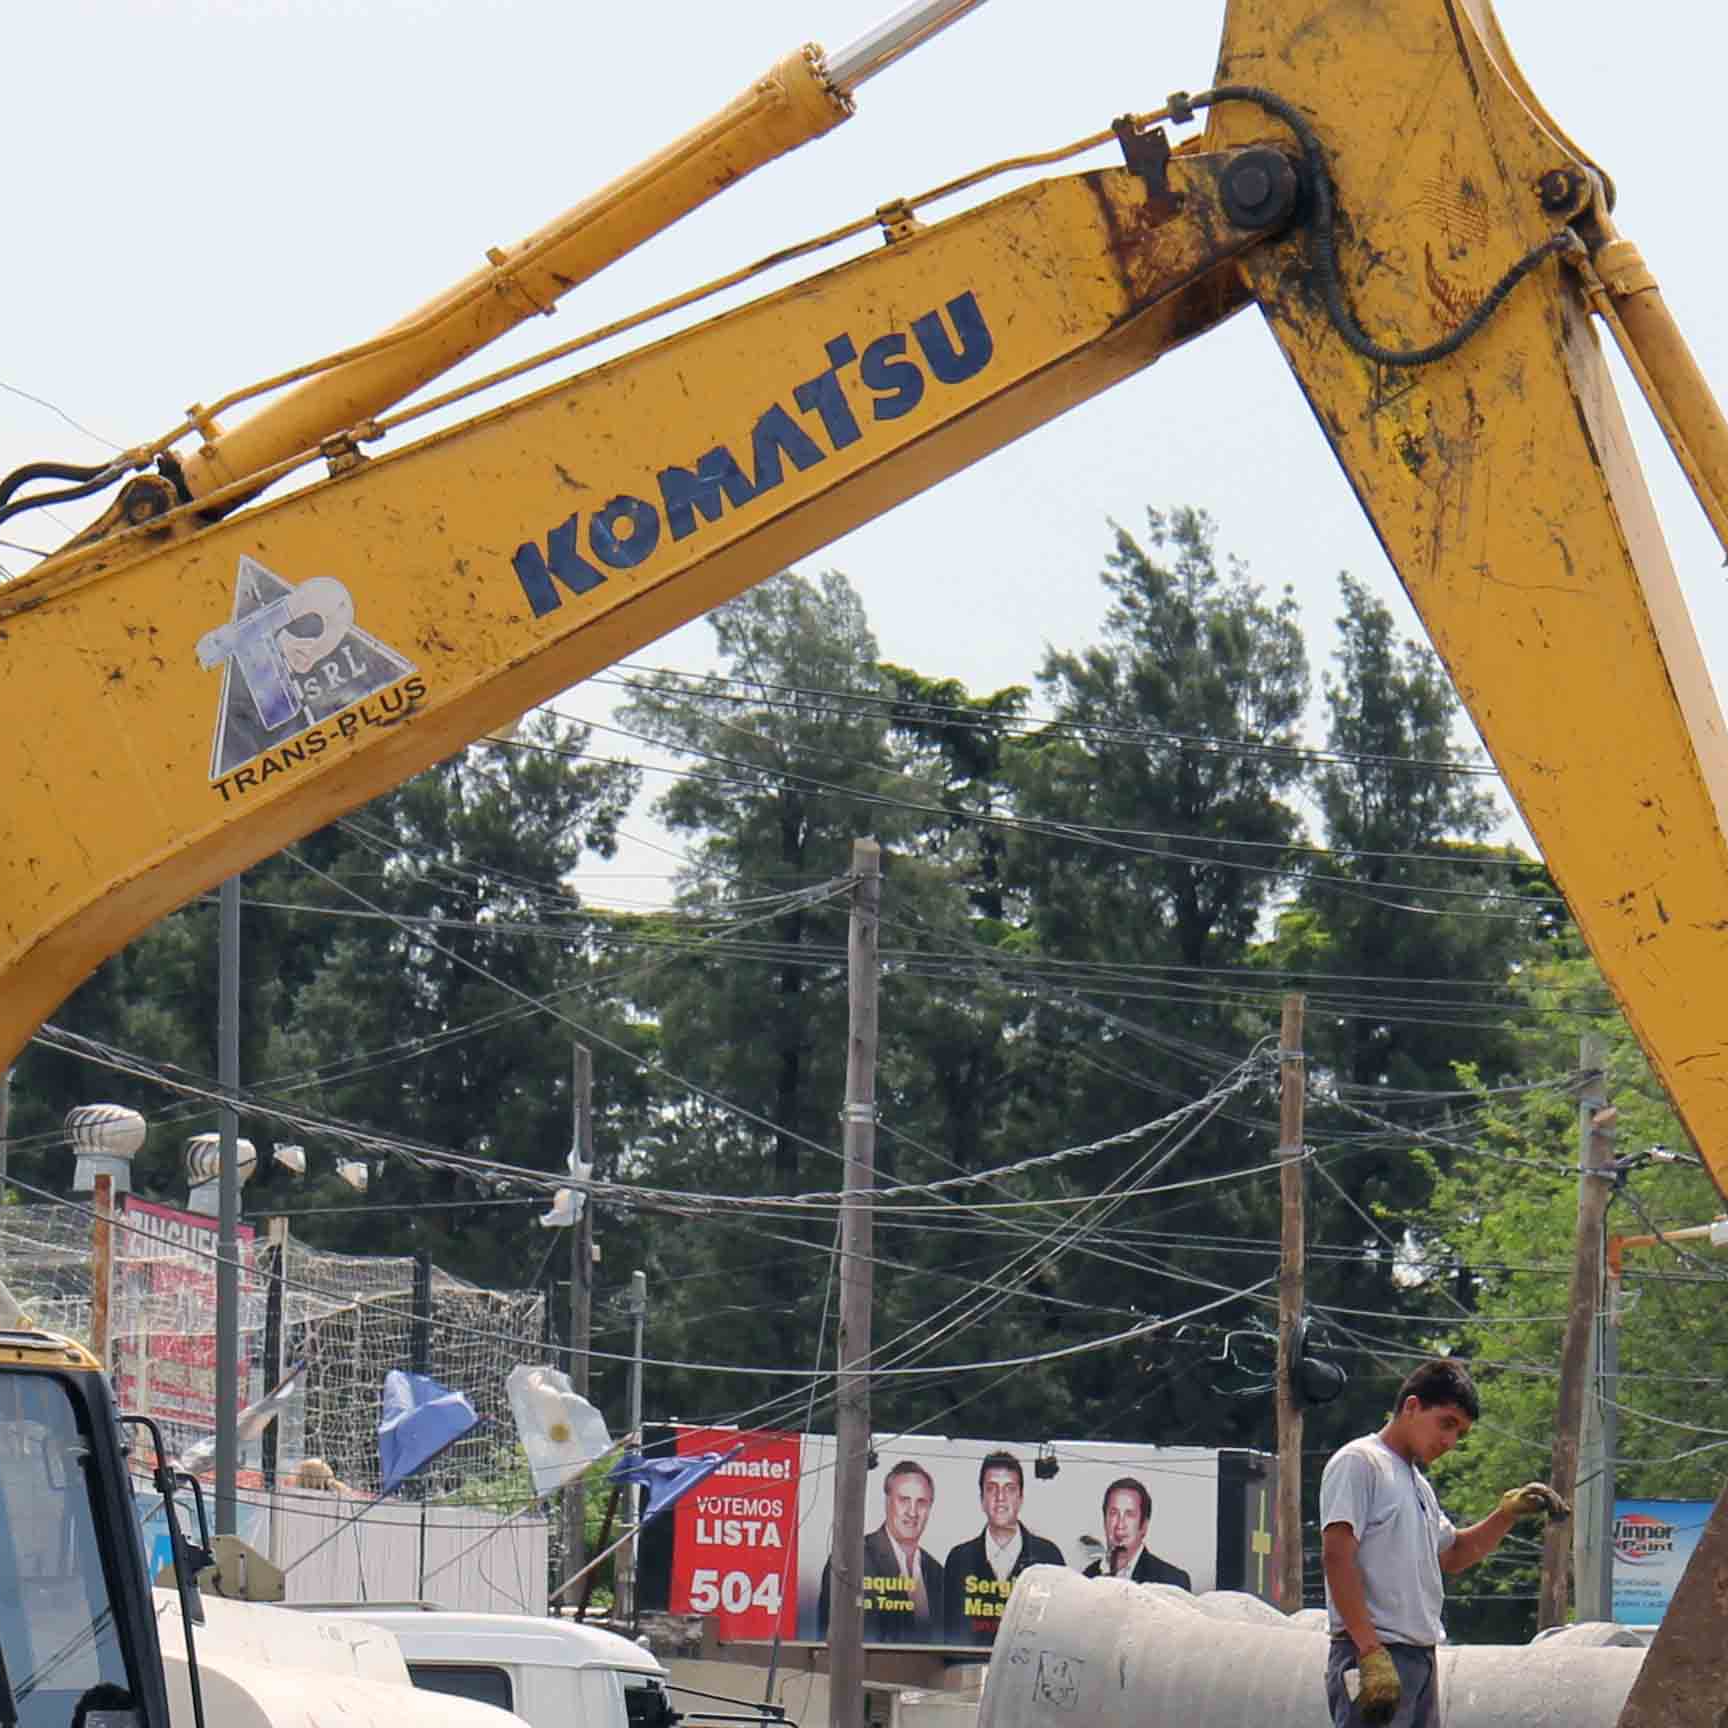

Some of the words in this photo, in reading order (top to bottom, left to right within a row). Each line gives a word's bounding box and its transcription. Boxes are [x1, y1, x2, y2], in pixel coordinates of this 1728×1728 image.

[512, 290, 992, 619] KOMATSU
[212, 677, 427, 802] TRANS-PLUS
[696, 1496, 783, 1518] VOTEMOS
[696, 1518, 782, 1548] LISTA
[689, 1569, 782, 1615] 504
